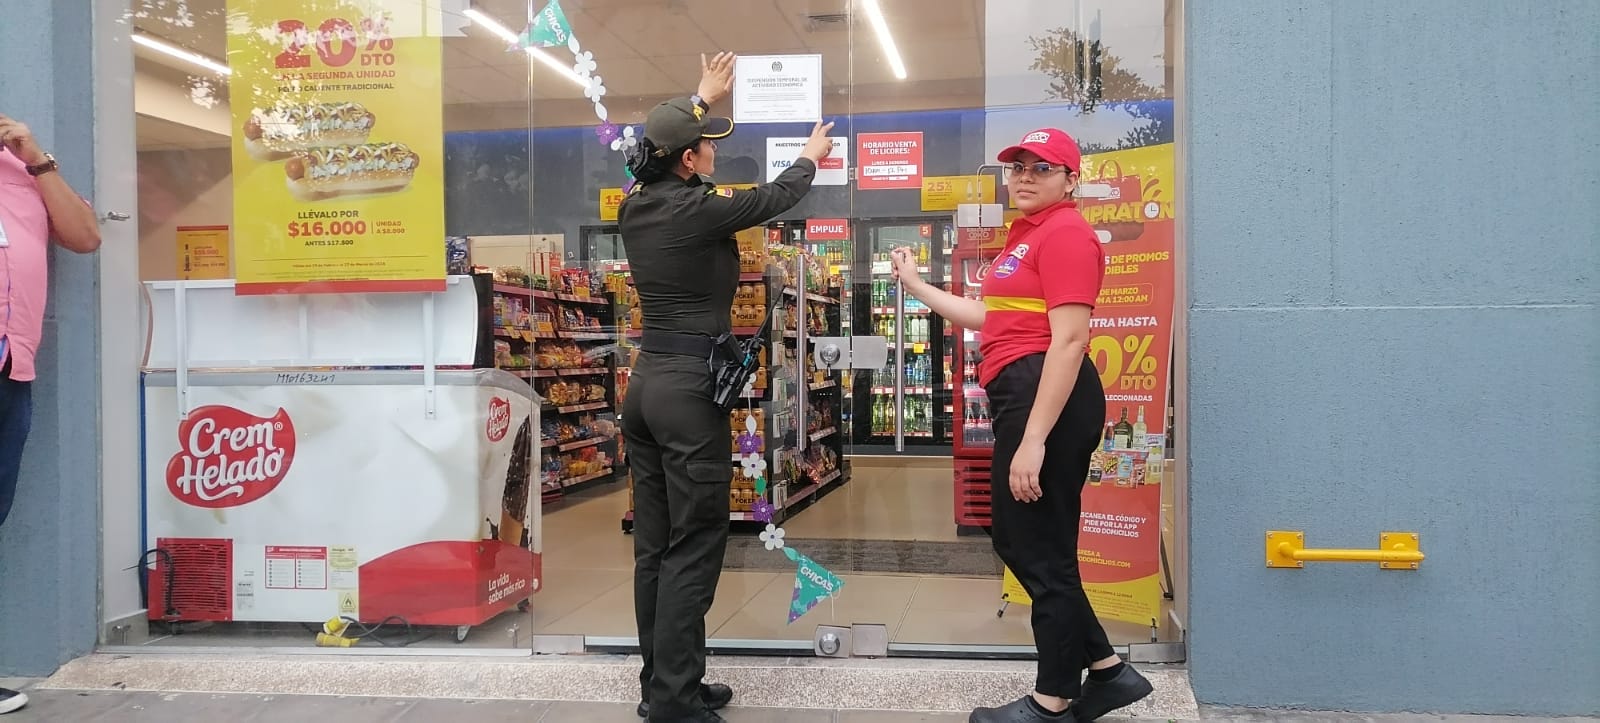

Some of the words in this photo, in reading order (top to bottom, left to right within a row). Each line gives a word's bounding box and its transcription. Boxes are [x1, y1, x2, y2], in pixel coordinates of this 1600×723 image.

[545, 7, 567, 43] CHICAS
[360, 53, 395, 67] DTO
[306, 71, 354, 80] SEGUNDA
[356, 70, 396, 78] UNIDAD
[343, 83, 395, 91] TRADICIONAL
[862, 141, 894, 149] HORARIO
[894, 140, 918, 148] VENTA
[771, 160, 792, 168] VISA
[298, 208, 338, 219] LLÉVALO
[339, 210, 360, 218] POR
[287, 220, 367, 238] $16.000
[810, 225, 844, 233] EMPUJE
[921, 226, 929, 234] 5
[1110, 254, 1125, 264] DE
[1125, 251, 1169, 263] PROMOS
[1104, 264, 1139, 275] DIBLES
[1111, 286, 1139, 295] MARZO
[1112, 295, 1135, 303] 12:00
[1135, 294, 1148, 303] AM
[1117, 316, 1158, 327] HASTA
[1120, 374, 1157, 391] DTO
[188, 417, 277, 458] Crem
[176, 447, 285, 501] Helado
[1101, 527, 1140, 538] DOMICILIOS
[488, 579, 497, 592] La
[496, 572, 510, 588] vida
[800, 565, 834, 592] CHICAS
[488, 589, 503, 605] sabe
[514, 578, 526, 591] rico
